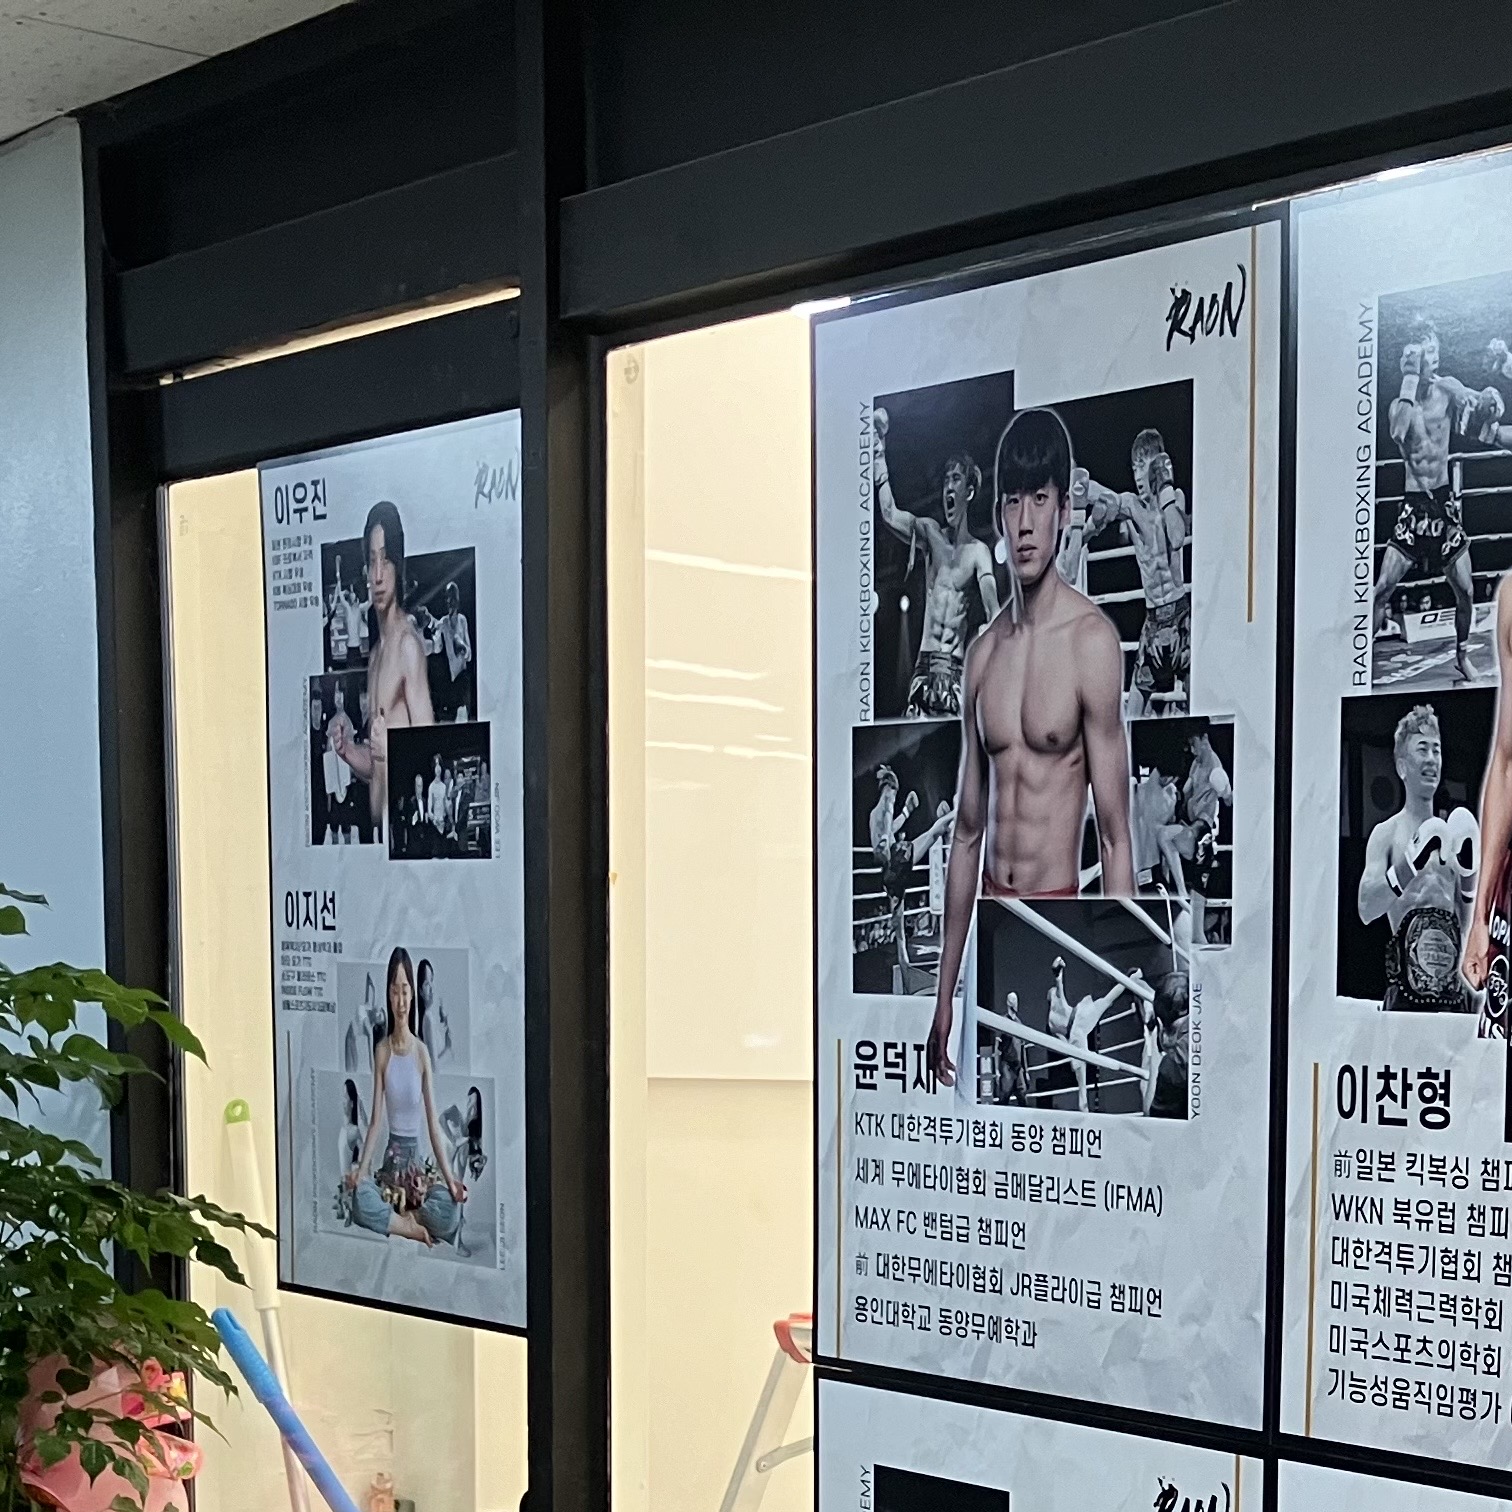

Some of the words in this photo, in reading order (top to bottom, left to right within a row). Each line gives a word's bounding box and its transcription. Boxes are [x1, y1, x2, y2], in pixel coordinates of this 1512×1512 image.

[1165, 263, 1247, 351] RAON
[1357, 302, 1372, 433] ACADEMY
[860, 403, 870, 511] ACADEMY
[275, 479, 327, 525] 이우진
[1355, 445, 1371, 603] KICKBOXING
[860, 521, 870, 652] KICKBOXING
[1353, 615, 1368, 685] RAON
[860, 662, 870, 721] RAON
[285, 891, 336, 930] 이지선
[1193, 984, 1202, 1014] JAE
[1192, 1021, 1201, 1065] DEOK
[1192, 1073, 1200, 1118] YOON
[1337, 1065, 1450, 1129] 이찬형
[856, 1112, 885, 1137] KTK
[892, 1114, 1002, 1149] 대한격투기협회
[1011, 1124, 1043, 1153] 동양
[1052, 1126, 1101, 1158] 챔피언
[855, 1158, 883, 1185] 세계
[892, 1161, 986, 1196] 무에타이협회
[994, 1171, 1096, 1207] 금메달리스트
[1105, 1181, 1162, 1217] (IFMA)
[1406, 1153, 1469, 1189] 킥복싱
[856, 1205, 890, 1231] MAX
[897, 1210, 916, 1234] FC
[924, 1212, 970, 1243] 밴텀급
[978, 1217, 1025, 1250] 챔피언
[1332, 1193, 1383, 1225] WKN
[1393, 1198, 1455, 1234] 북유럽
[877, 1253, 1002, 1295] 대한무에타이협회
[1010, 1273, 1101, 1309] JR플라이급
[1110, 1283, 1161, 1317] 챔피언
[1332, 1236, 1481, 1283] 대한격투기협회
[855, 1296, 931, 1331] 용인대학교
[939, 1308, 1037, 1348] 동양무예학과
[1330, 1281, 1503, 1333] 미국체력근력학회
[1329, 1325, 1502, 1378] 미국스포츠의학회
[1328, 1368, 1501, 1424] 기능성움직임평가
